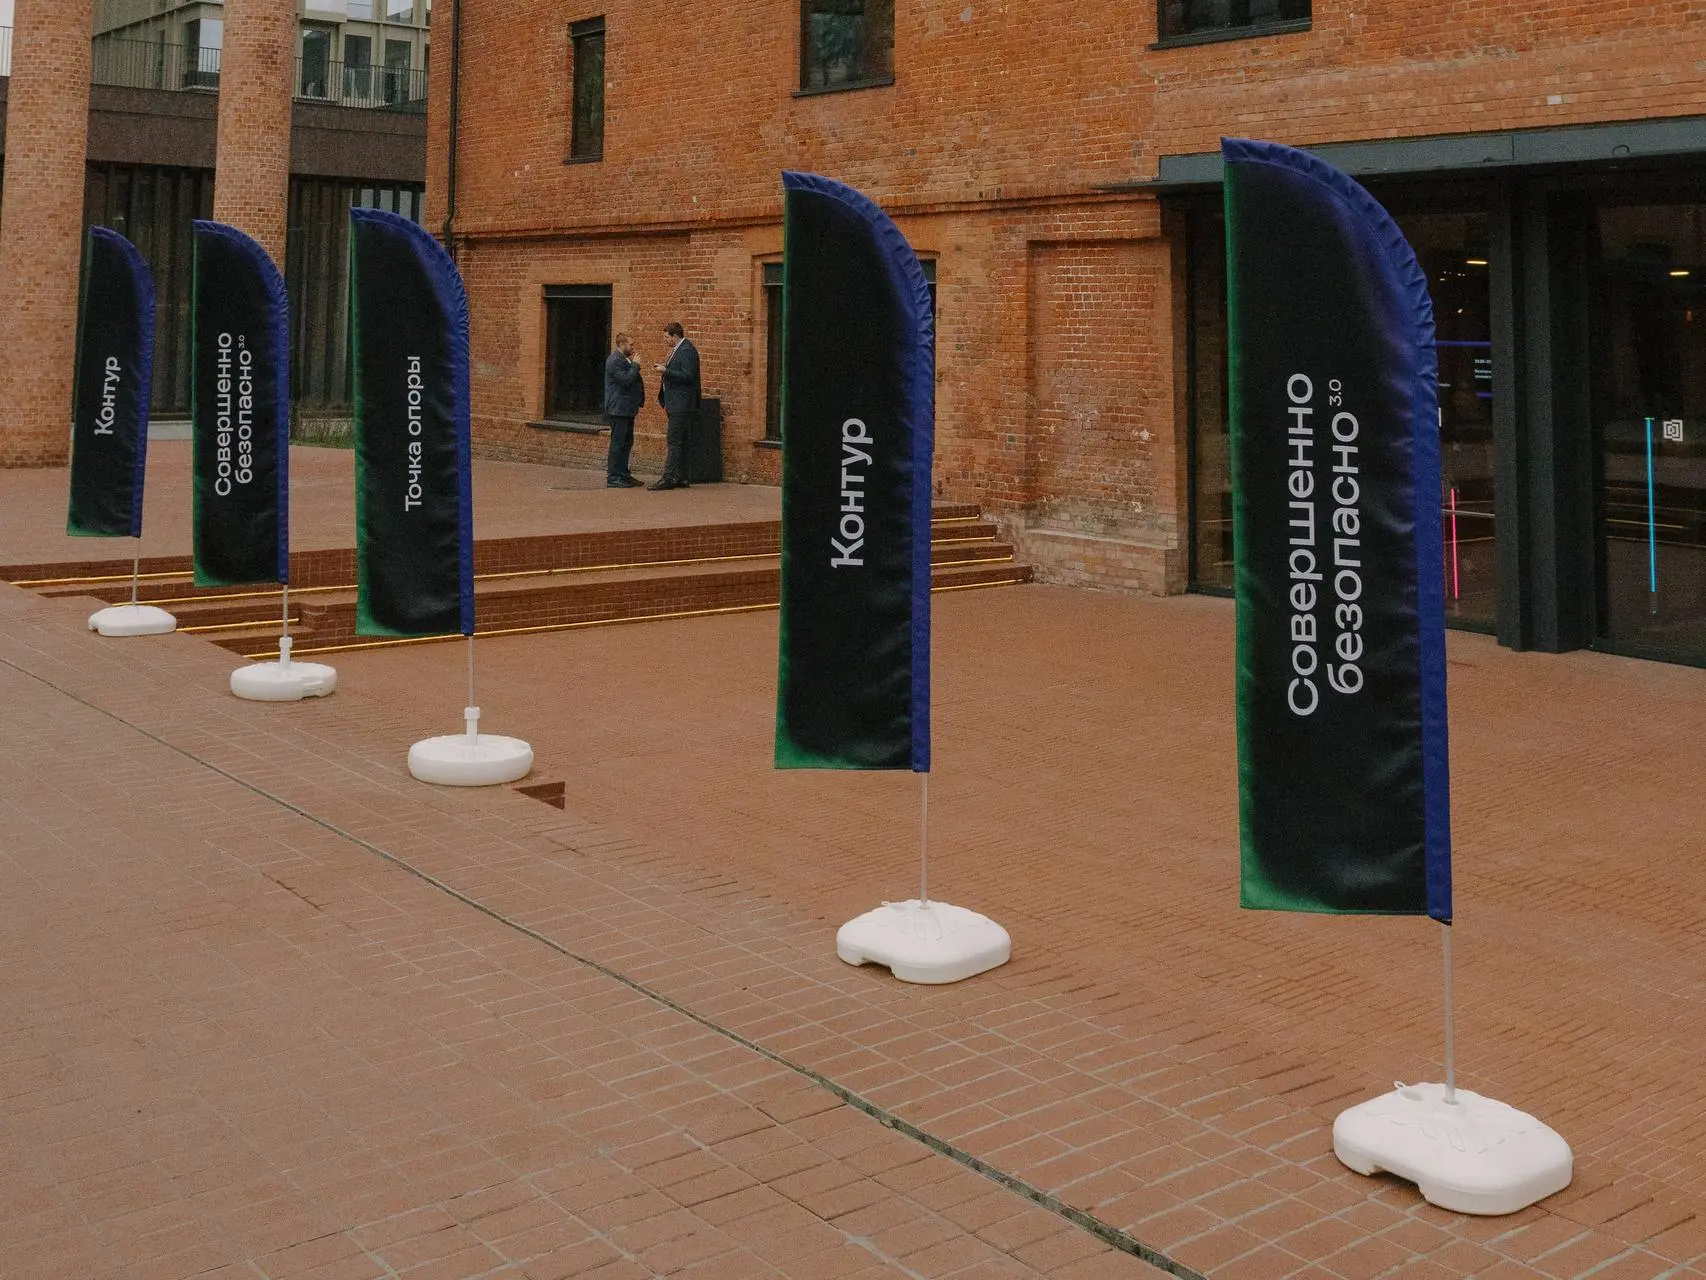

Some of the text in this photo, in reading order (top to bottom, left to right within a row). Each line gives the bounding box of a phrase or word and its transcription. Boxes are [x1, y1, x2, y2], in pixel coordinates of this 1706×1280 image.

[94, 356, 123, 436] Контур
[214, 332, 236, 497] Совершенно
[234, 349, 254, 485] безопасно
[404, 355, 425, 512] Точка опоры
[830, 417, 874, 569] Контур
[1286, 373, 1324, 717] Совершенно
[1325, 378, 1364, 695] безопасно 3.0
